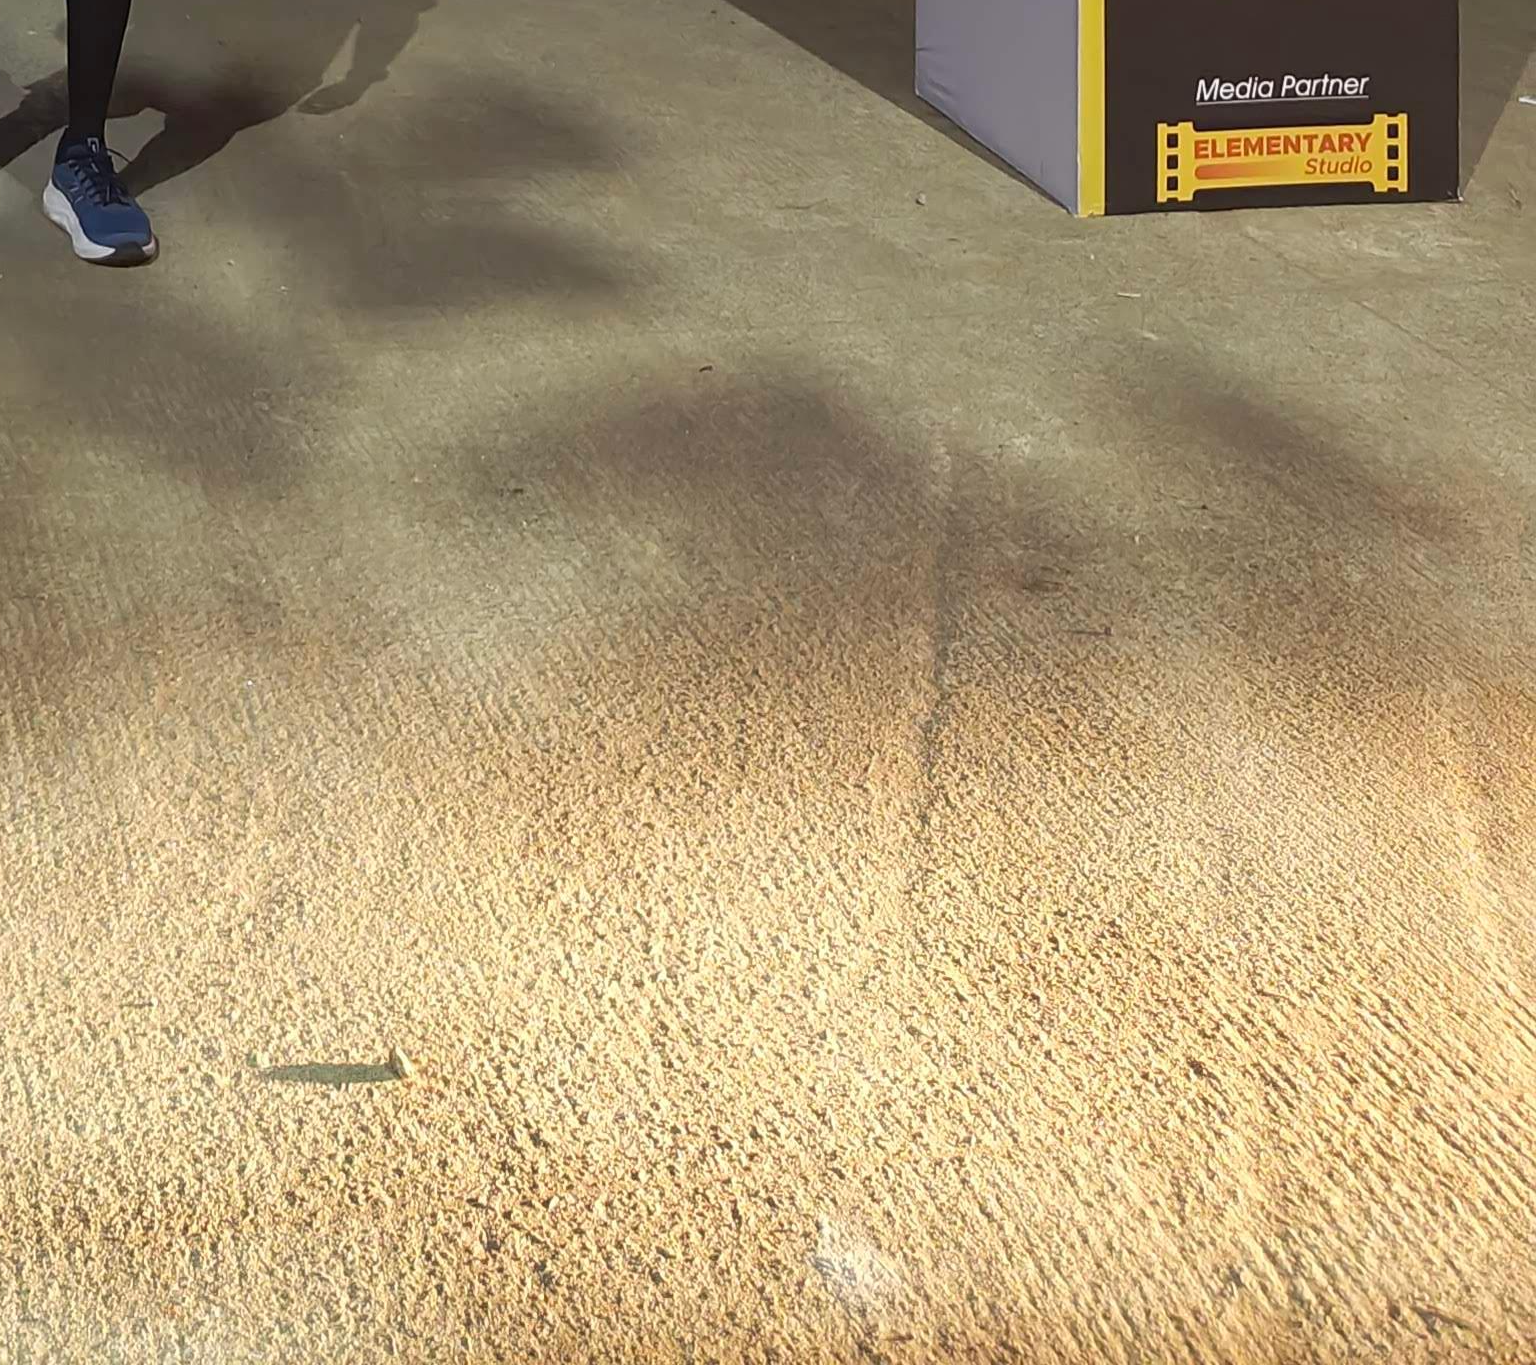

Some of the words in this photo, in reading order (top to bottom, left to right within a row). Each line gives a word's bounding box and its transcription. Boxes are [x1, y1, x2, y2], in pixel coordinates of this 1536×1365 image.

[1195, 77, 1274, 101] Media
[1281, 75, 1369, 98] Partner
[1194, 132, 1373, 160] ELEMENTARY
[1304, 156, 1373, 175] Studio
